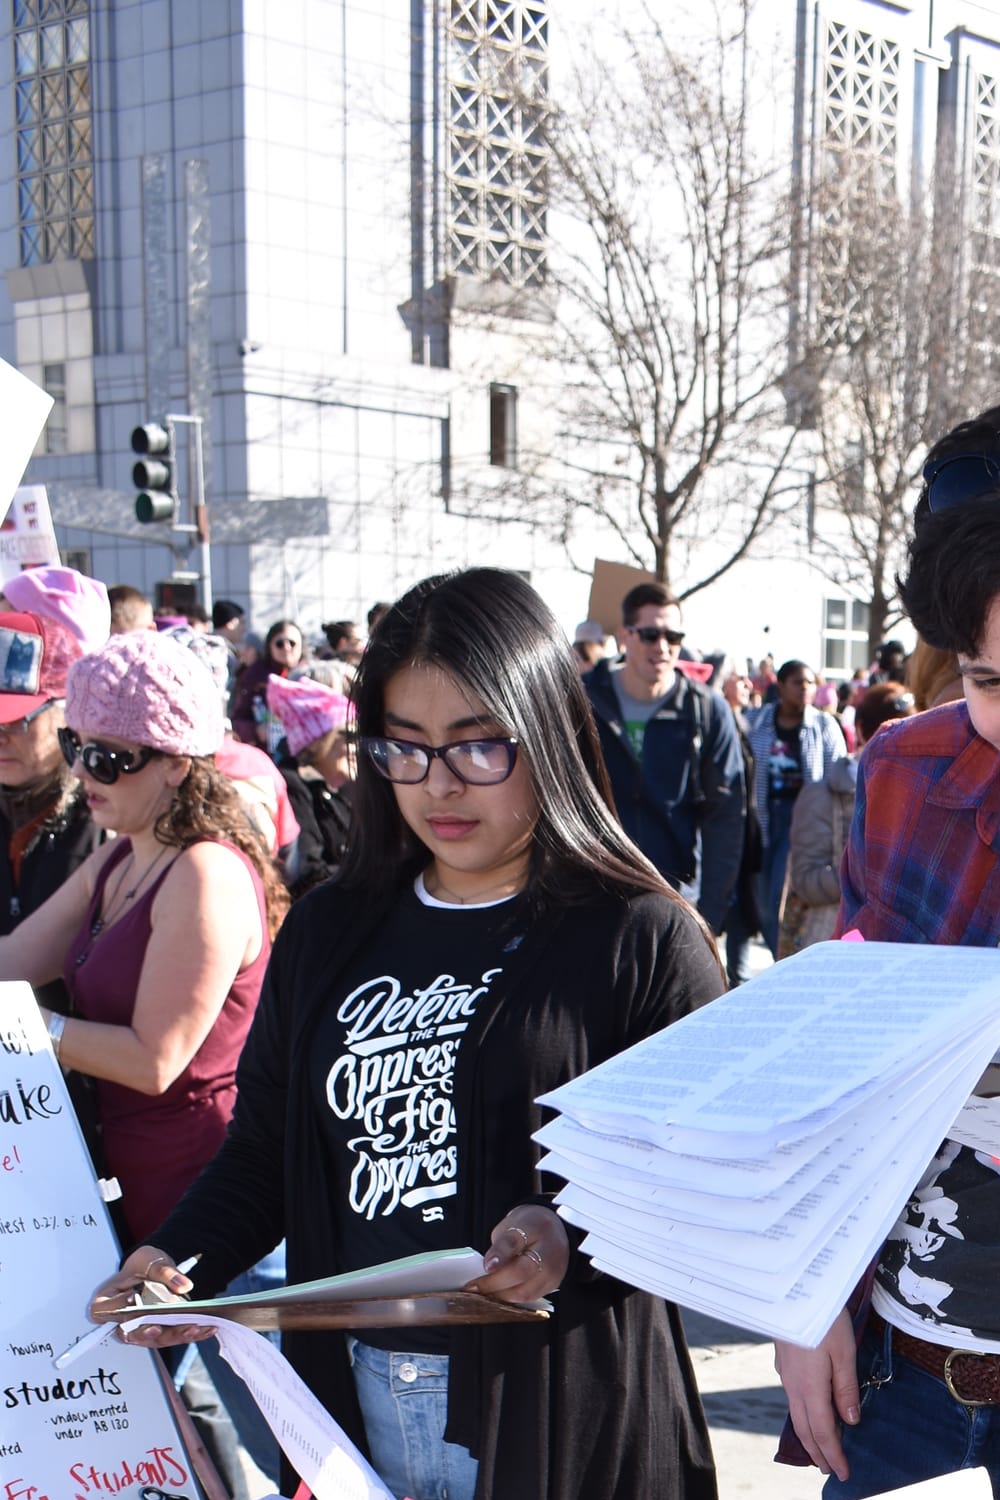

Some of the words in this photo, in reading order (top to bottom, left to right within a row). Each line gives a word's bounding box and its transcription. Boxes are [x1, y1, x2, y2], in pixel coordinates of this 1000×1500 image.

[409, 1027, 437, 1042] THE
[405, 1139, 432, 1155] THE
[10, 1343, 54, 1358] housing
[3, 1367, 122, 1409] students
[55, 1429, 83, 1441] under
[94, 1420, 109, 1434] AB
[110, 1418, 129, 1431] 130
